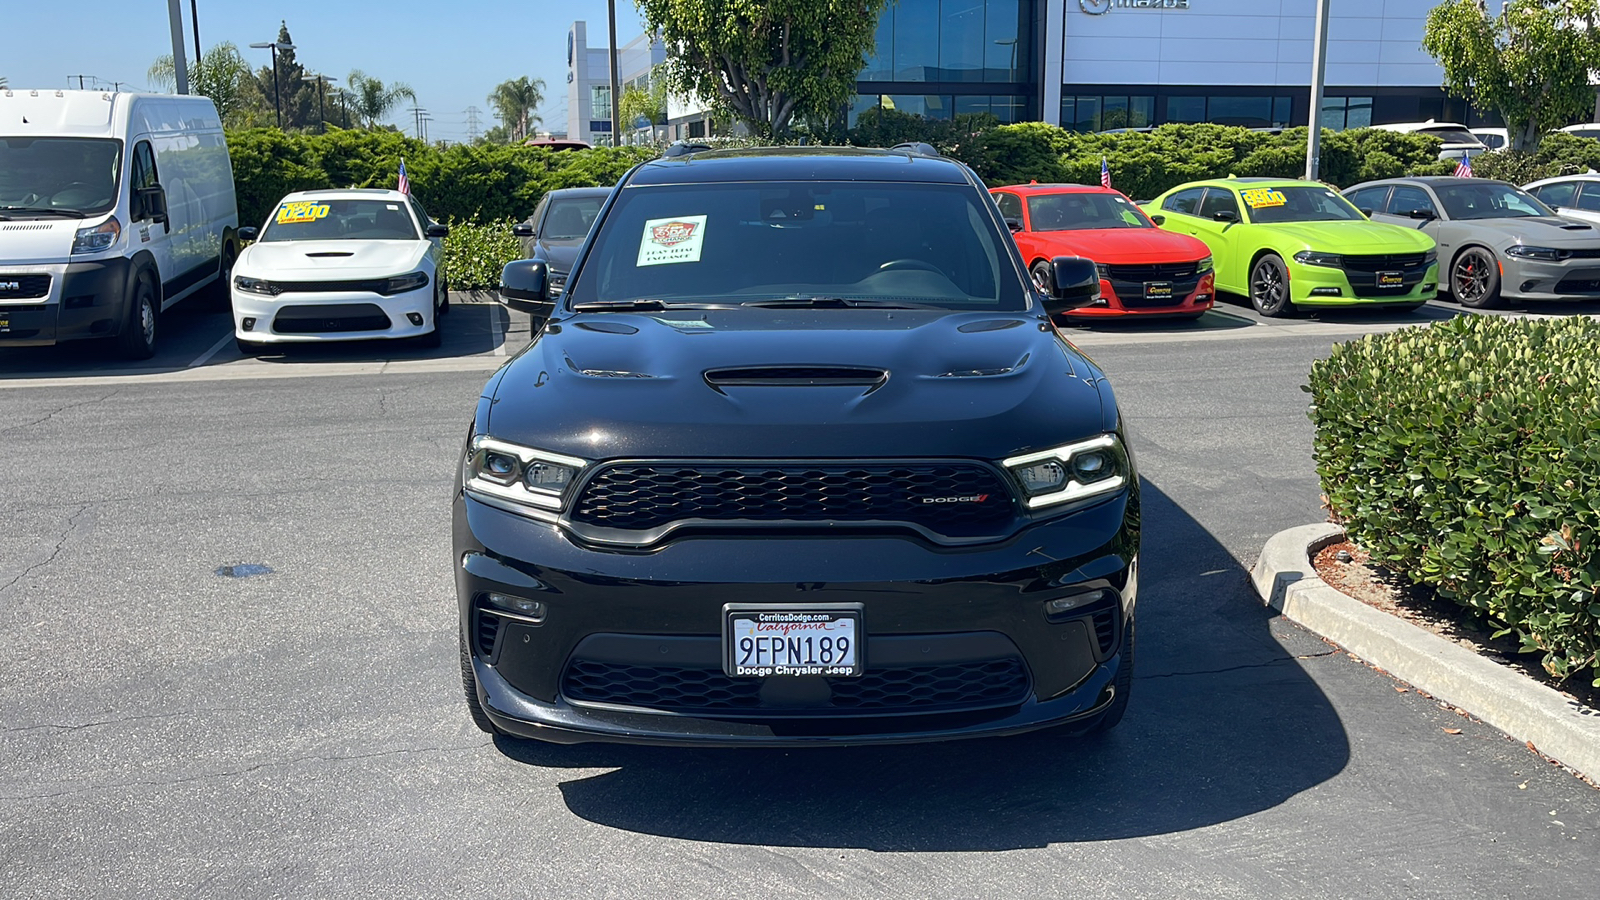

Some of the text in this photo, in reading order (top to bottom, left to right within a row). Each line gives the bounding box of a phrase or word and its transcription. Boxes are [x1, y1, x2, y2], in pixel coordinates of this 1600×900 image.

[1310, 156, 1320, 166] 12
[922, 495, 979, 504] DODGE
[758, 613, 830, 623] CerritosDodge.com
[757, 622, 835, 636] California
[739, 636, 850, 665] 9FPN189
[736, 665, 853, 677] Dodge Chrysler Jeep
